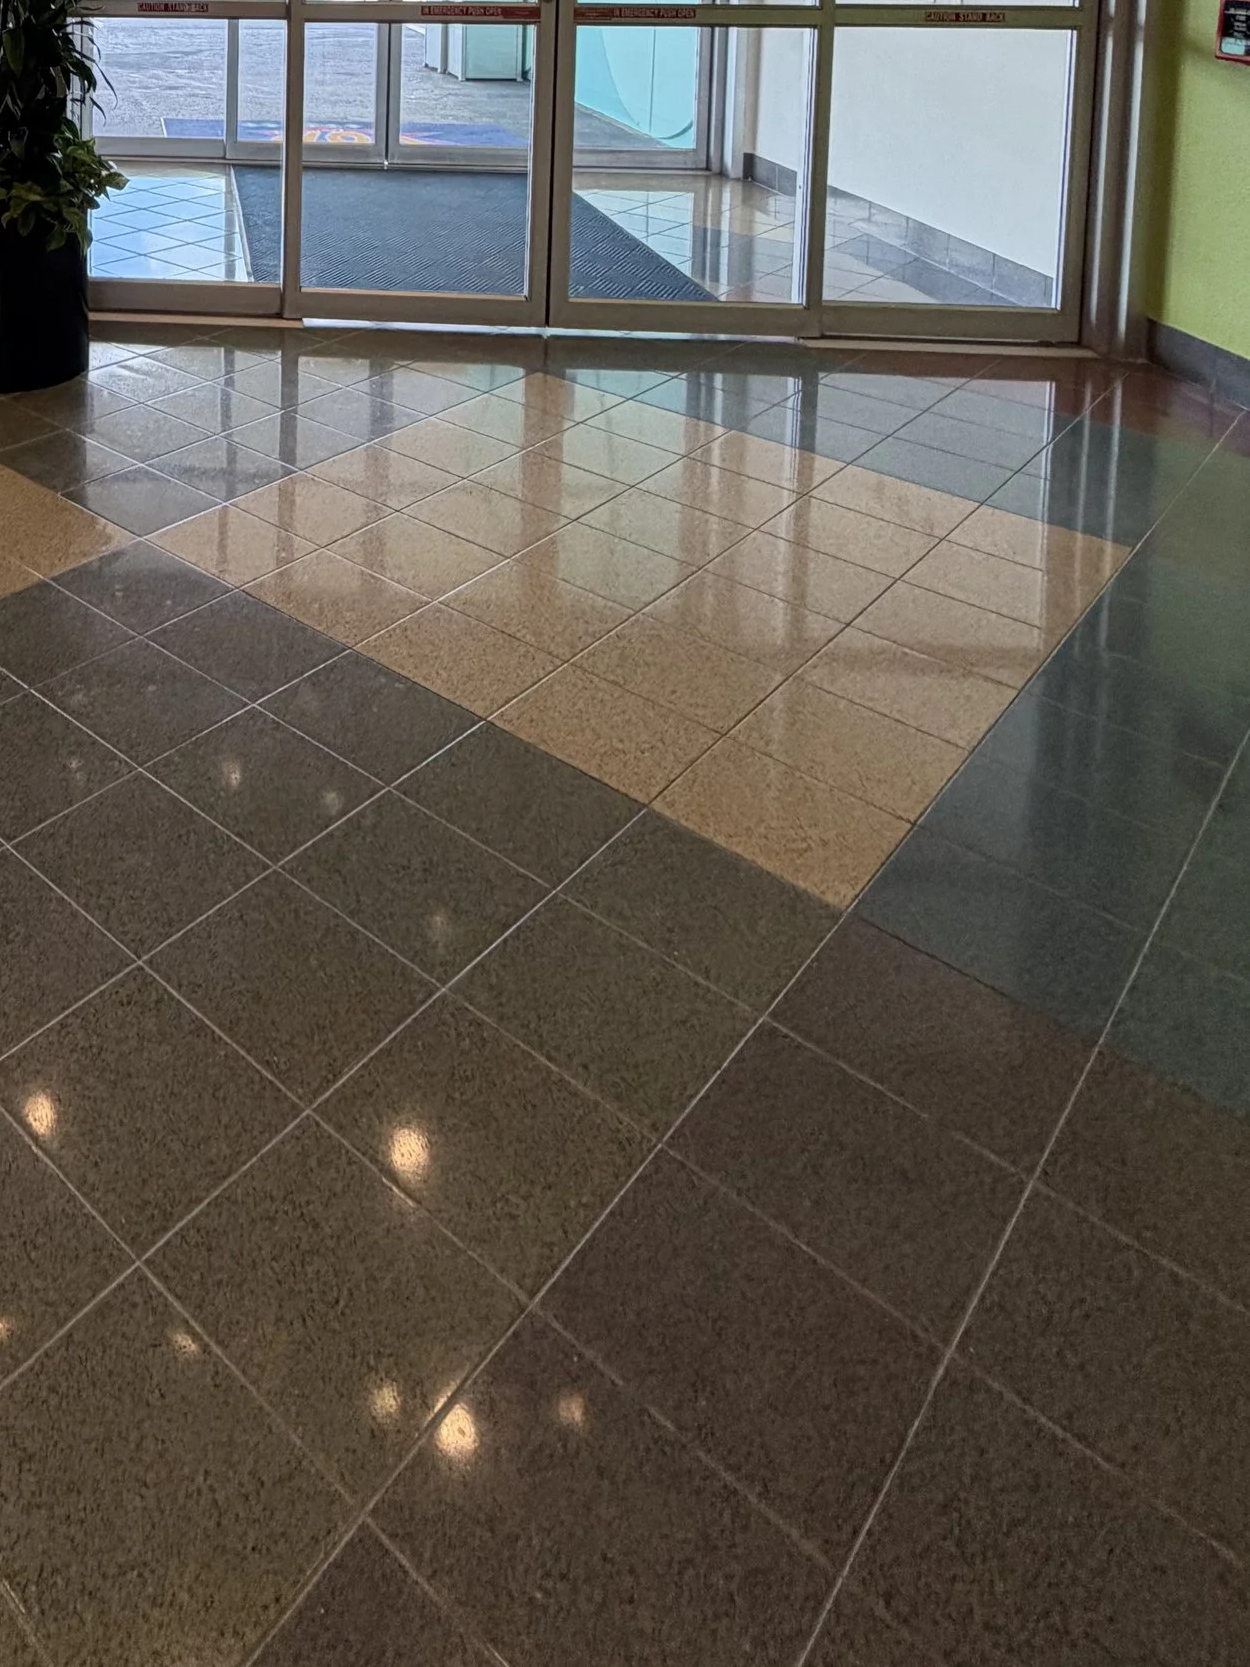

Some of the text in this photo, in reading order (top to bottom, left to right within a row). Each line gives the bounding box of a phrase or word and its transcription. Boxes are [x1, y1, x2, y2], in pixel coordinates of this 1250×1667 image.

[431, 5, 466, 15] EMERGENCY
[468, 5, 484, 15] PUSH
[485, 5, 502, 15] OPEN
[660, 9, 676, 18] PUSH
[678, 9, 694, 18] OPEN
